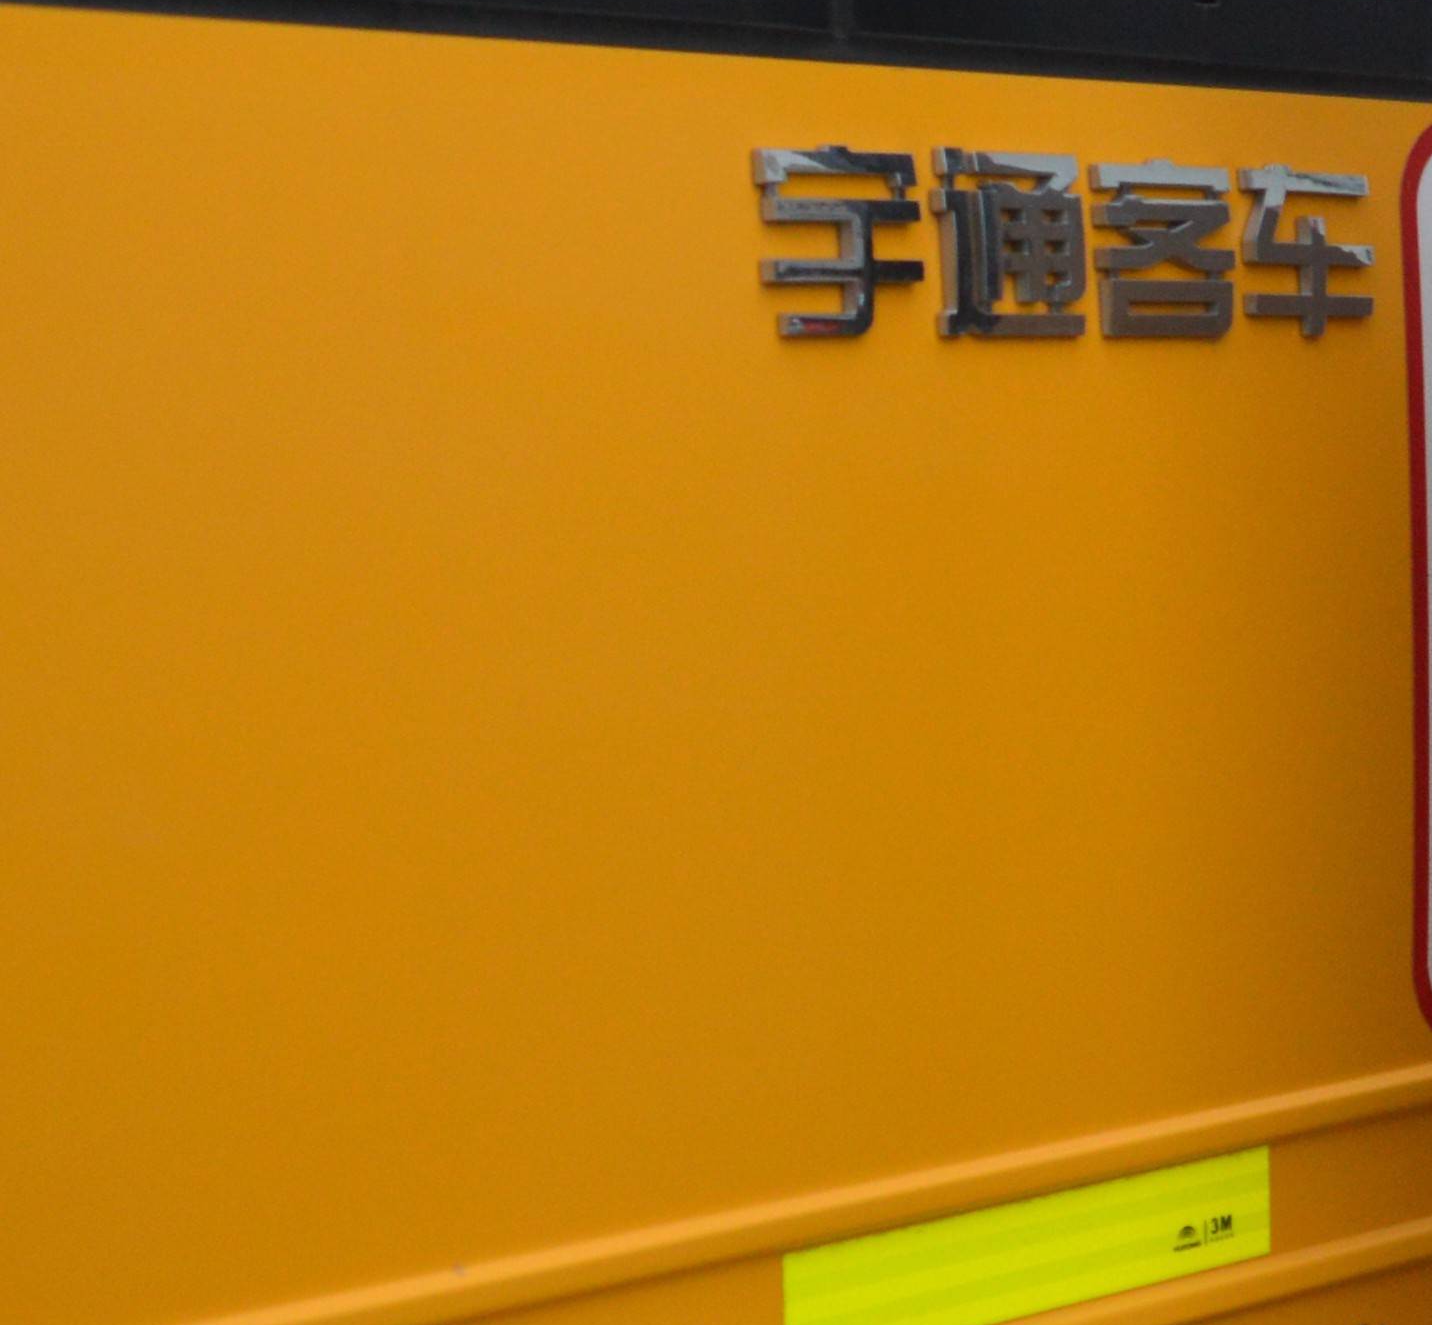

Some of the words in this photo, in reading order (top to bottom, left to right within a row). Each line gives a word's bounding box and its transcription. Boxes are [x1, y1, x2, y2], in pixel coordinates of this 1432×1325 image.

[752, 145, 1375, 339] 宇通客车
[1210, 1214, 1233, 1235] 3M
